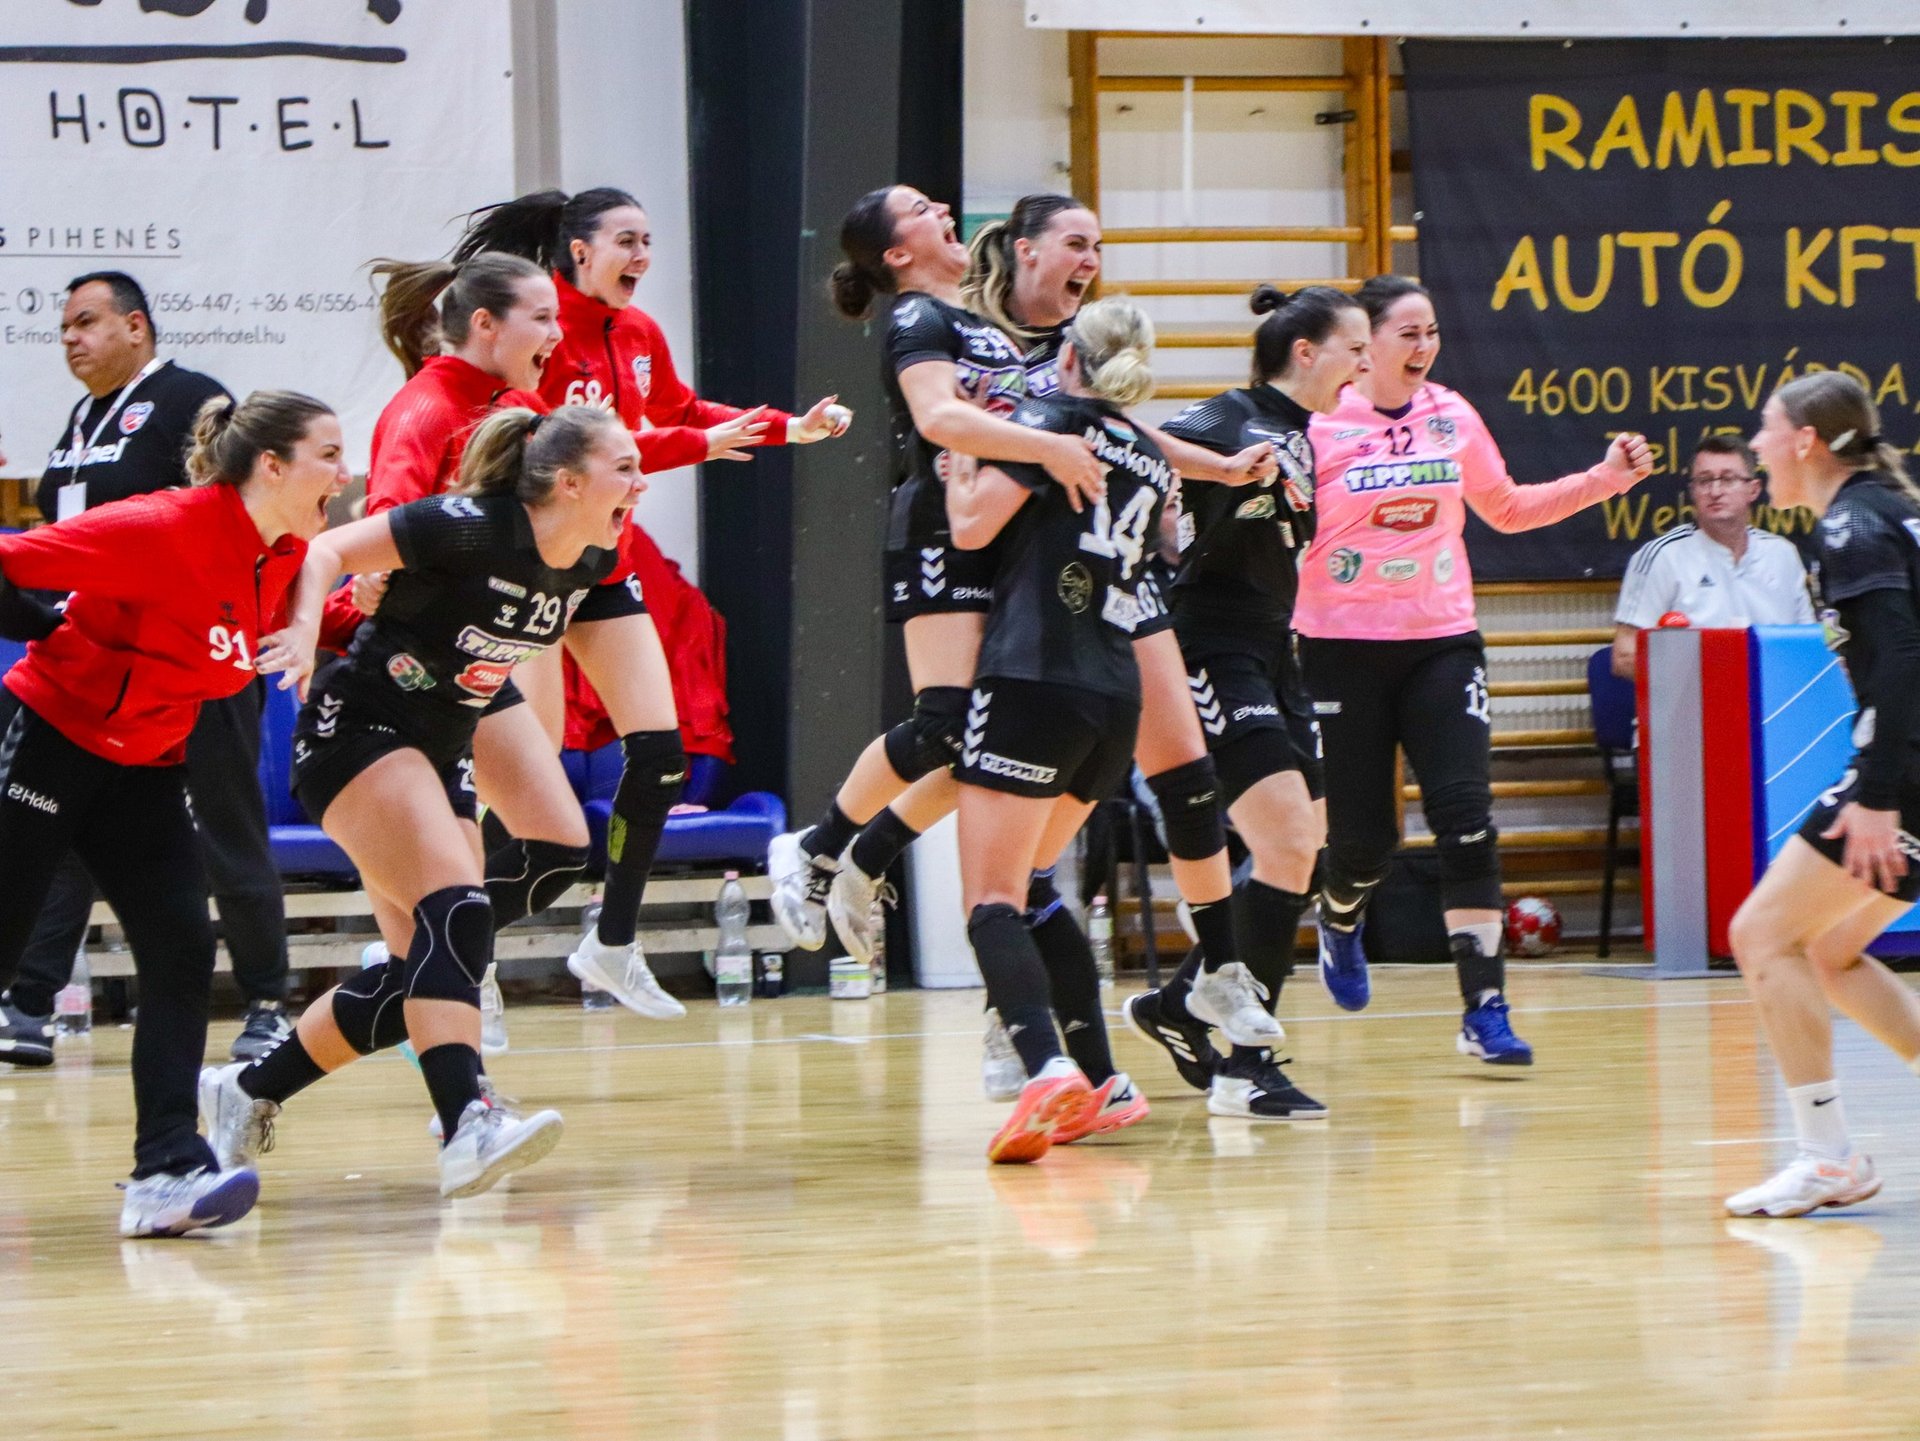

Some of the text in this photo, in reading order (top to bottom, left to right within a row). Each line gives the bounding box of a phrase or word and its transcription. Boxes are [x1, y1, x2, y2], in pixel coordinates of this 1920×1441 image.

[1529, 88, 1920, 169] RAMIRIS
[28, 224, 181, 249] PIHENÉS
[1492, 199, 1920, 311] AUTÓ KFT
[250, 292, 288, 312] +36
[565, 380, 602, 407] 68
[1508, 367, 1631, 414] 4600
[1384, 425, 1416, 456] 12
[1079, 463, 1158, 581] 14
[522, 592, 562, 636] 29
[209, 625, 254, 670] 91
